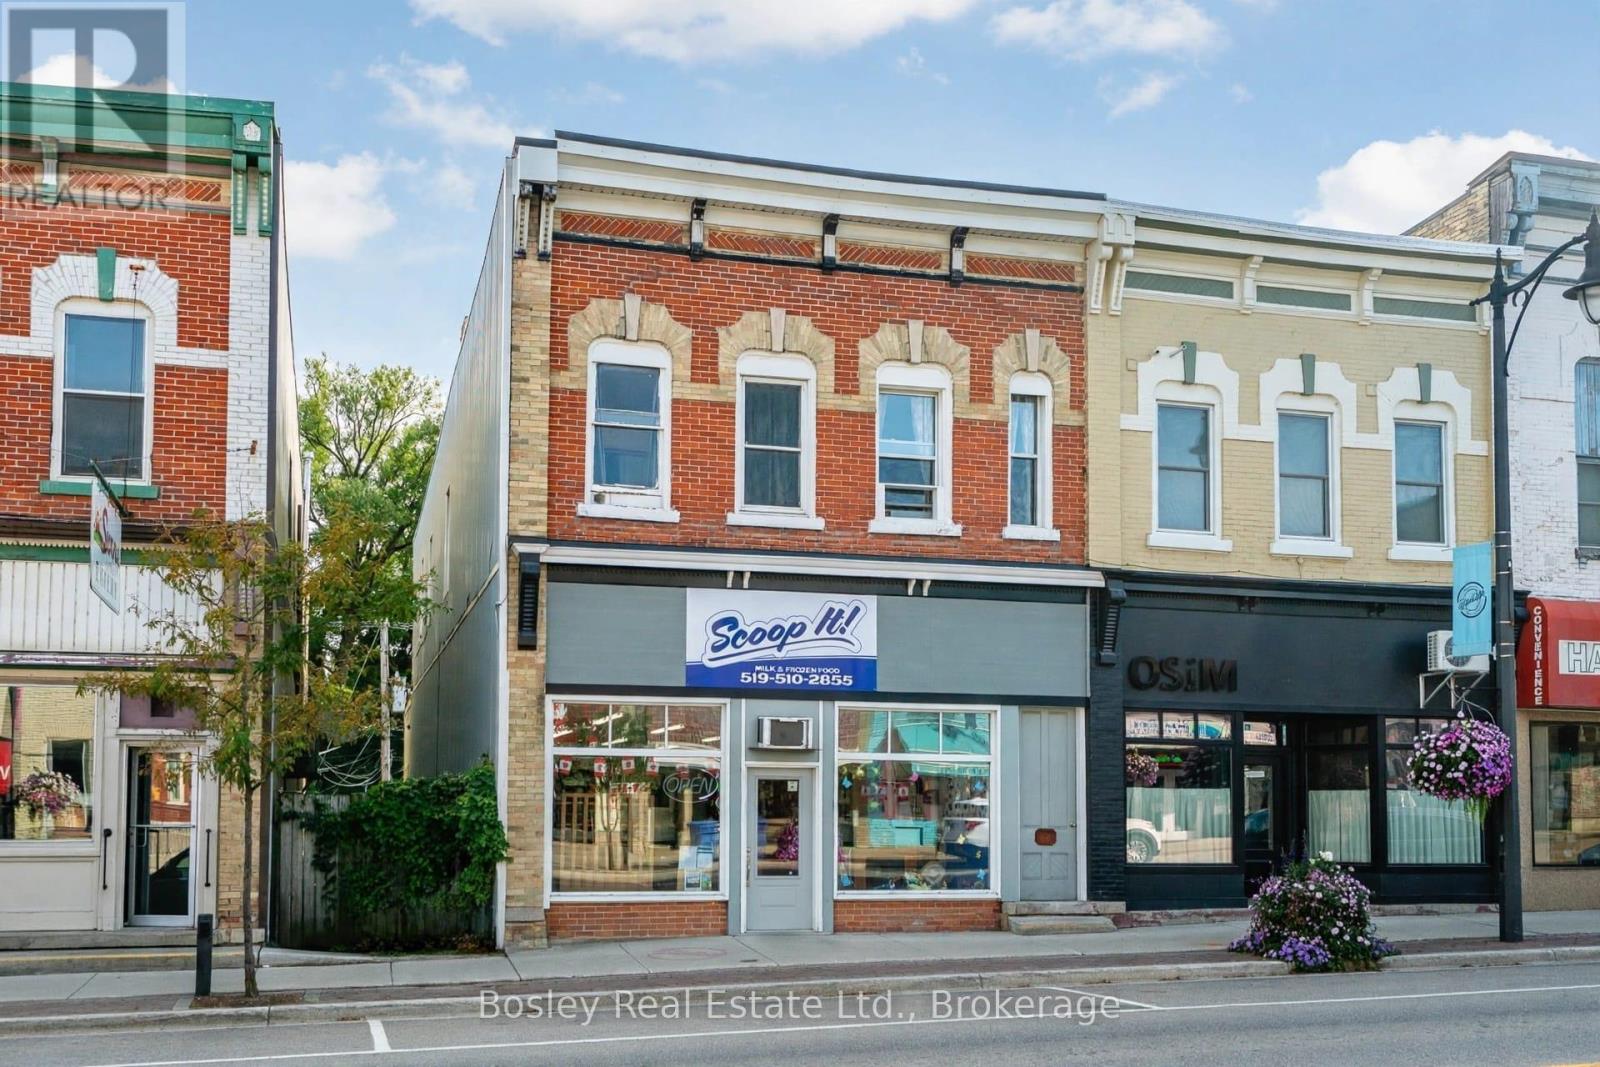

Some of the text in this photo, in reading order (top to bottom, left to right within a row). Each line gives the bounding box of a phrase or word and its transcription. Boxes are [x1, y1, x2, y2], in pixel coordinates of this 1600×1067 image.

[711, 606, 861, 653] Scoop It!
[754, 665, 776, 673] MILK
[1533, 606, 1543, 705] CONVENIENCE
[740, 672, 853, 686] 519-510-2855
